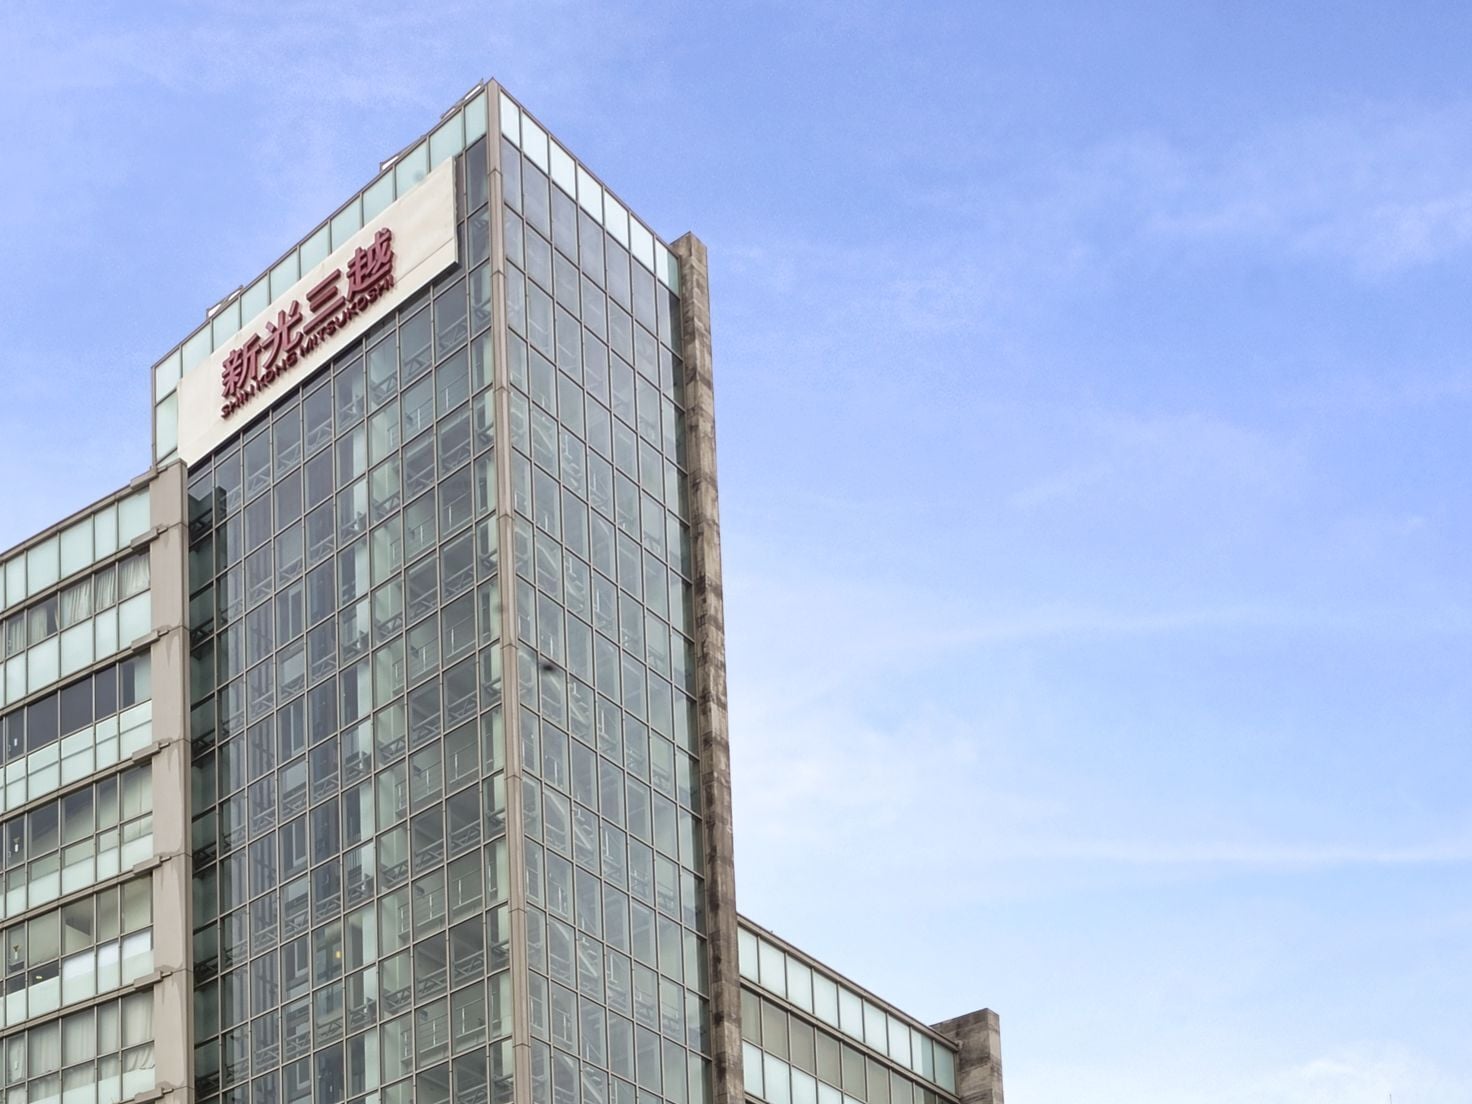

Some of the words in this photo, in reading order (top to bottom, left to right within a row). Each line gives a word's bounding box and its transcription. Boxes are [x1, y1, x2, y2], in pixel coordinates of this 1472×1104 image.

[222, 228, 395, 397] 新光三越
[301, 274, 395, 360] MITSUKOSHI
